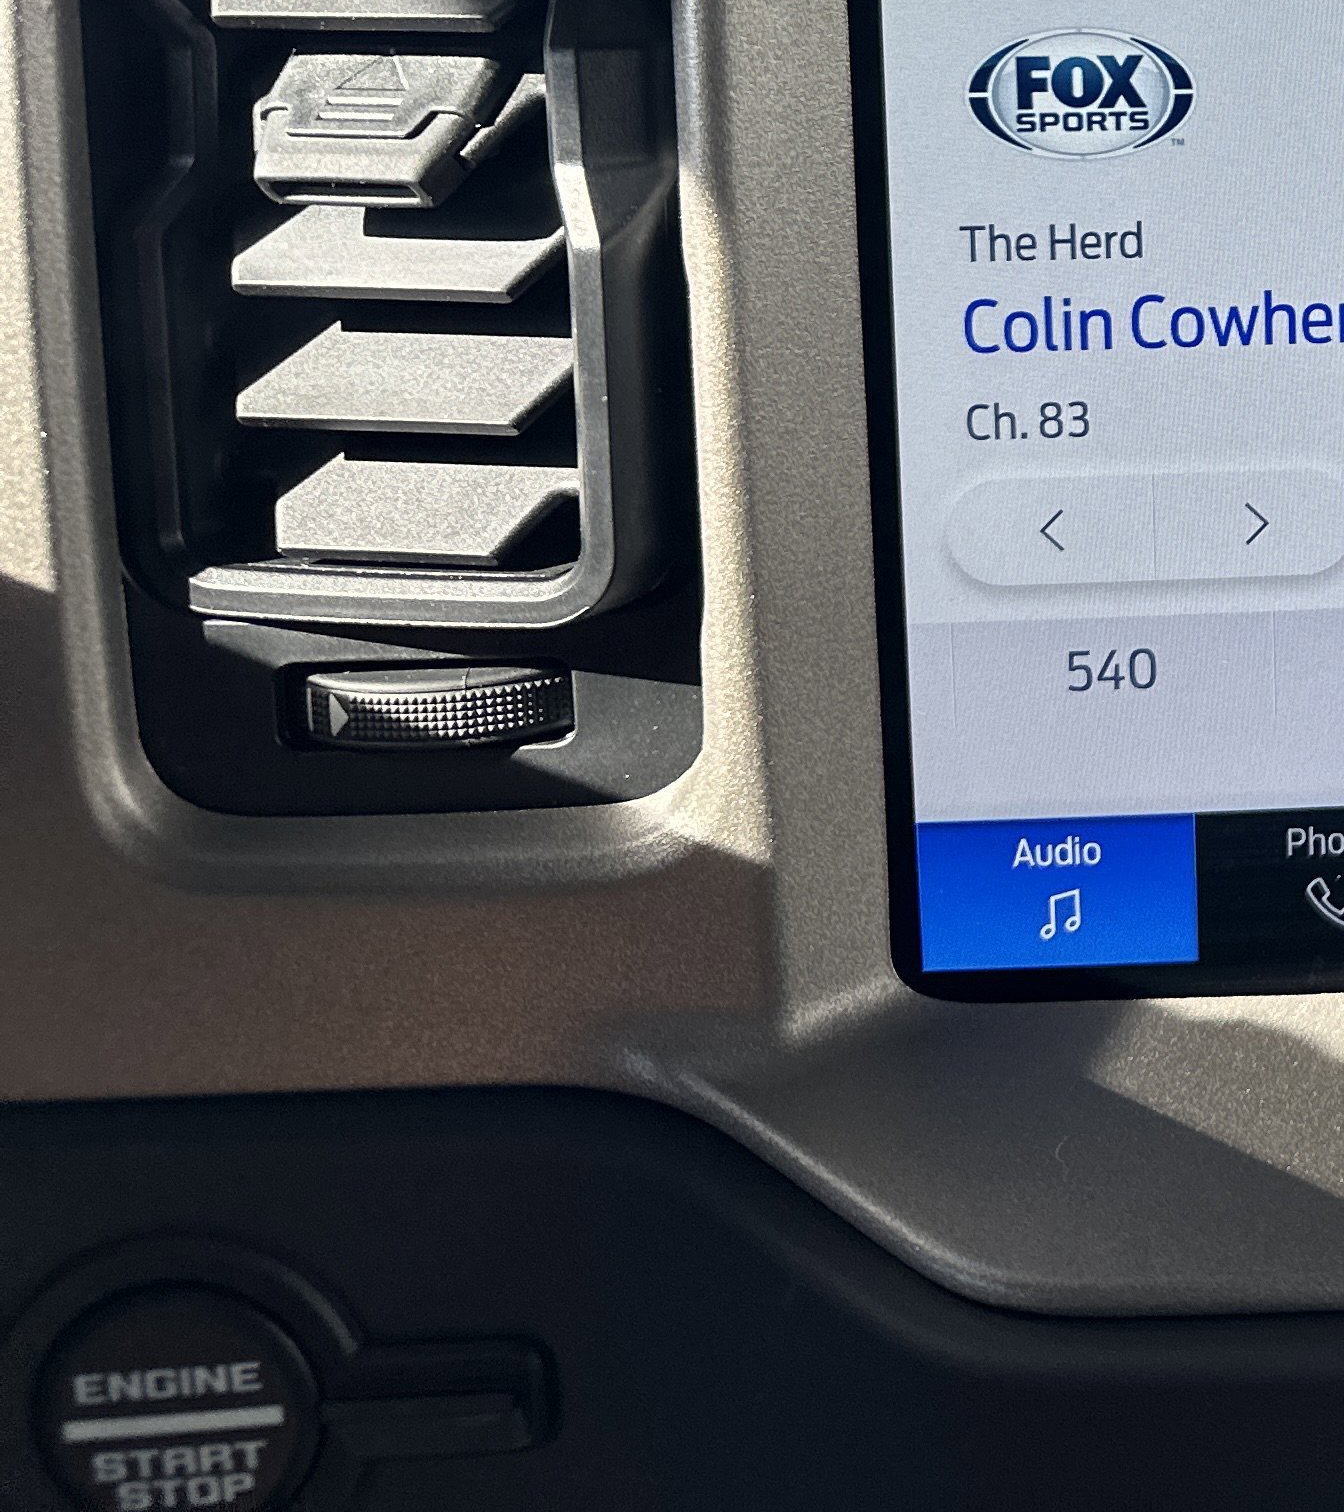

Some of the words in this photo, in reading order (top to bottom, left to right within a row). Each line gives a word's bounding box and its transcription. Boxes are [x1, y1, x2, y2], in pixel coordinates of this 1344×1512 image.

[1014, 54, 1149, 110] FOX
[1015, 110, 1150, 133] SPORTS
[958, 223, 1038, 263] The
[1049, 220, 1144, 261] Herd
[963, 295, 1113, 354] Colin
[966, 402, 1028, 441] Ch.
[1039, 400, 1090, 439] 83
[1068, 648, 1157, 692] 540
[1012, 835, 1102, 869] Audio
[72, 1361, 262, 1405] ENGINE
[93, 1439, 268, 1483] START
[117, 1471, 256, 1511] STOP
